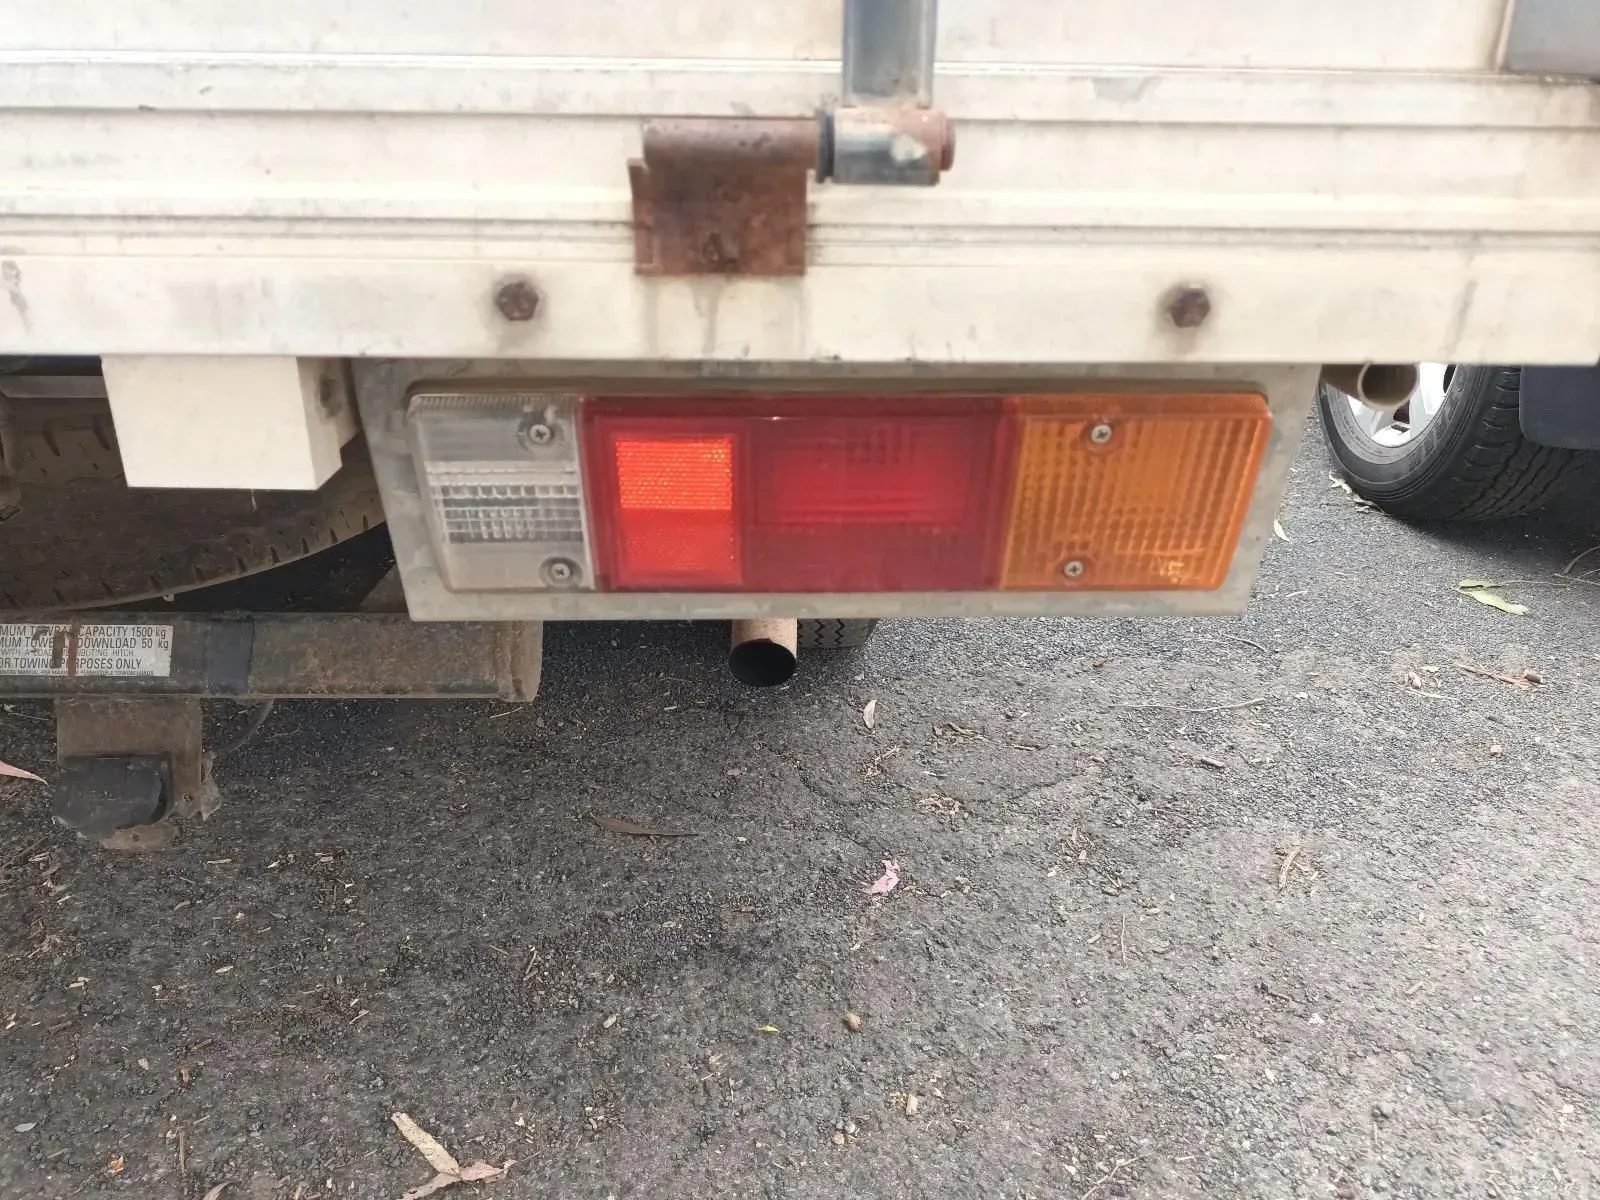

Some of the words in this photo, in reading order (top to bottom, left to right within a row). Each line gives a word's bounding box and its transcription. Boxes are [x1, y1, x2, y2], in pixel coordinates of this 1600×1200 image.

[78, 626, 129, 637] CAPACITY
[132, 626, 153, 637] 1500
[155, 627, 166, 639] kg
[77, 637, 137, 648] DOWNLOAD
[141, 638, 153, 649] 50
[157, 638, 169, 651] kg
[112, 649, 134, 657] HITCH
[116, 658, 142, 669] ONLY
